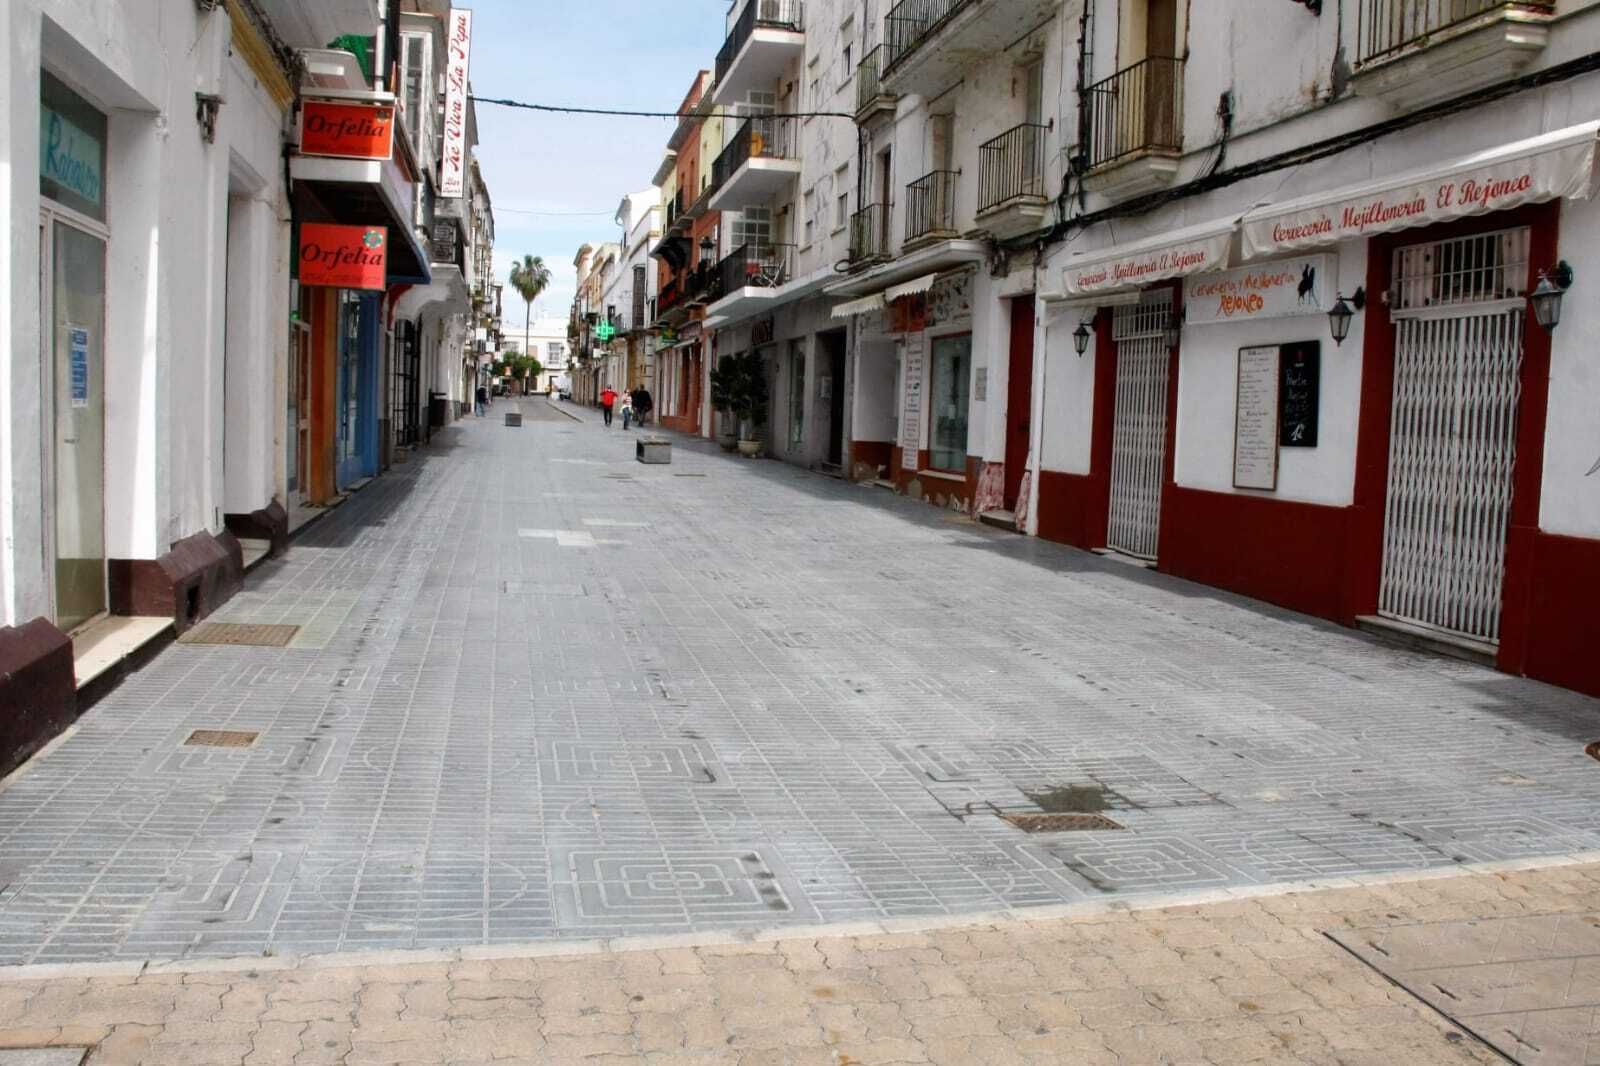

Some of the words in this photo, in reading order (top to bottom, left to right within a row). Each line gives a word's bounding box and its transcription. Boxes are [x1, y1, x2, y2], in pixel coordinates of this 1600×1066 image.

[451, 14, 469, 60] Pepa
[449, 66, 464, 96] La
[306, 112, 385, 139] Orfelia
[446, 101, 462, 140] Viva
[1437, 182, 1455, 208] El
[1458, 174, 1531, 208] Rejoneo
[301, 243, 383, 271] Orfelia
[1159, 254, 1168, 271] El
[1169, 251, 1205, 270] Rejoneo
